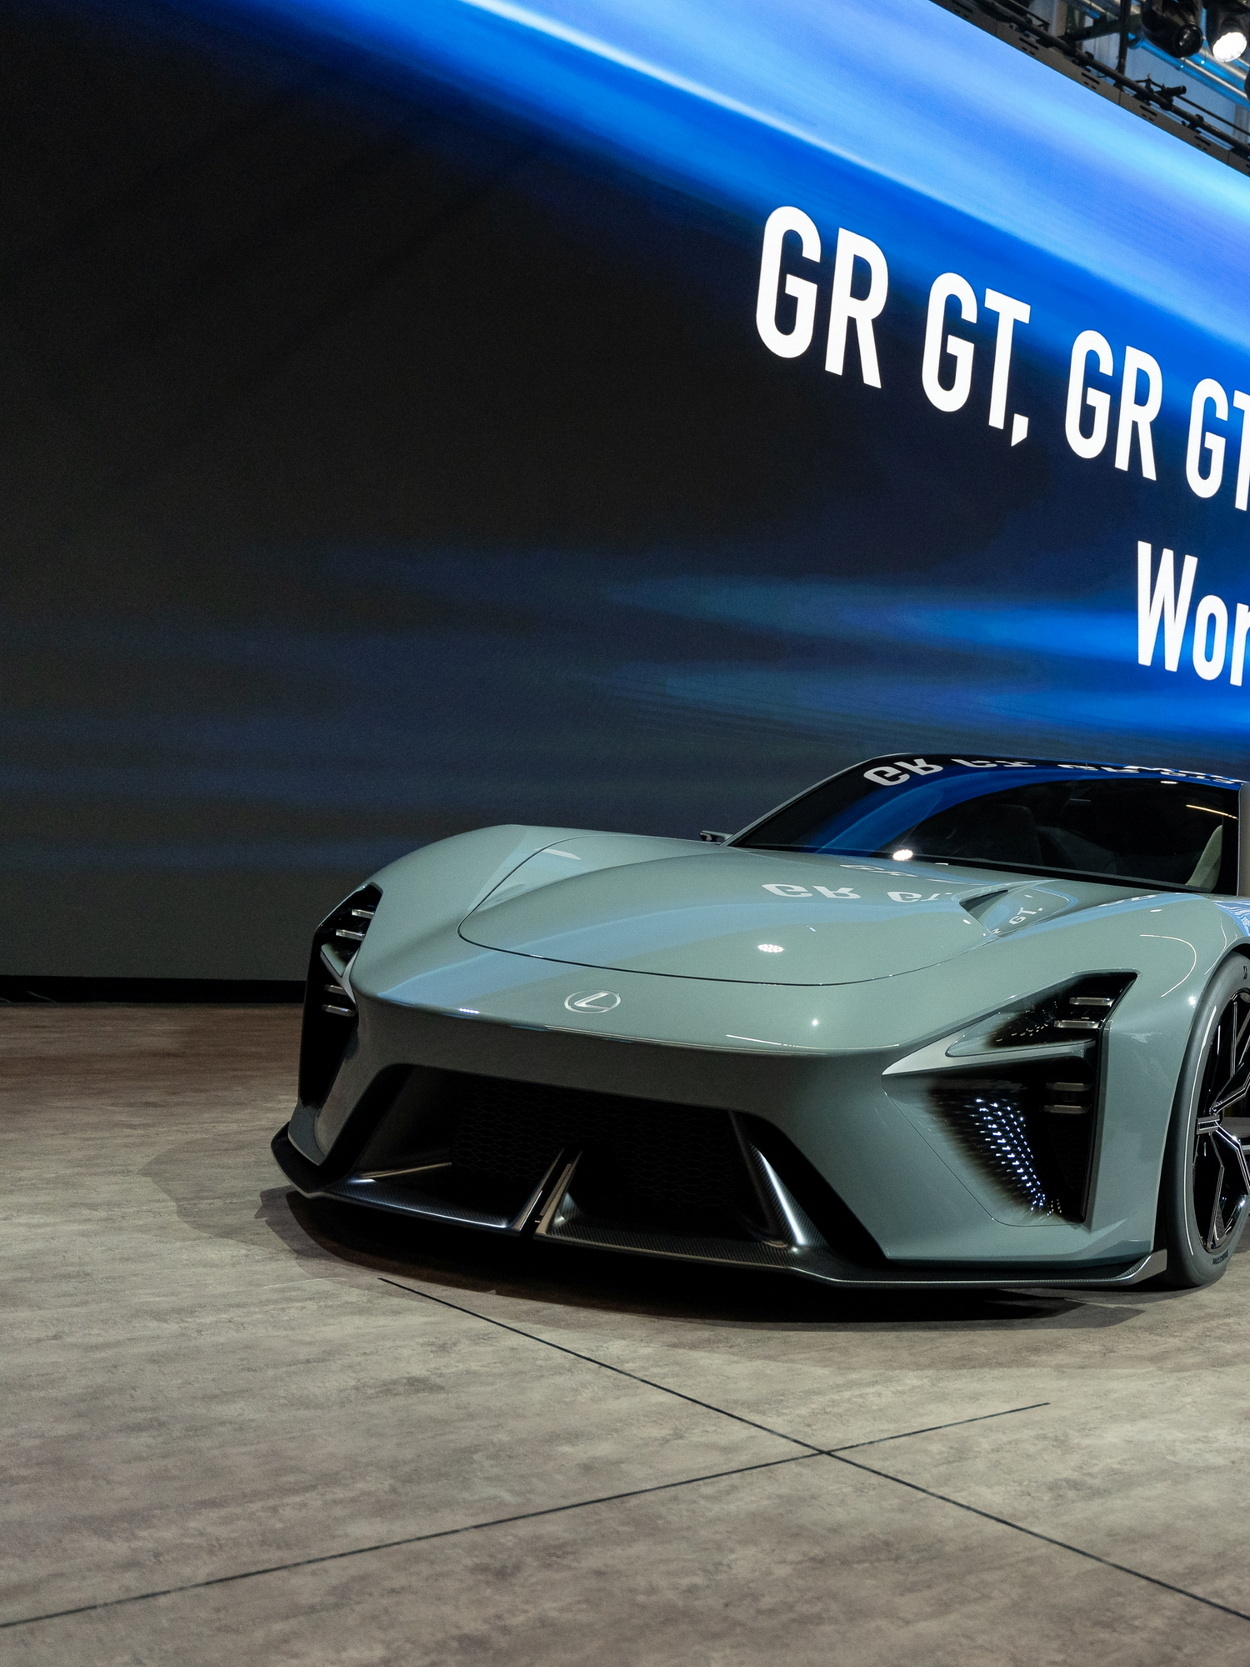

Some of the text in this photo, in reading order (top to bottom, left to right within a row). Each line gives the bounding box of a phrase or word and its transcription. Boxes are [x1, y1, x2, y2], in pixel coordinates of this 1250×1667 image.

[756, 206, 889, 389] GR
[921, 272, 1031, 447] GT,
[1064, 330, 1163, 481] GR
